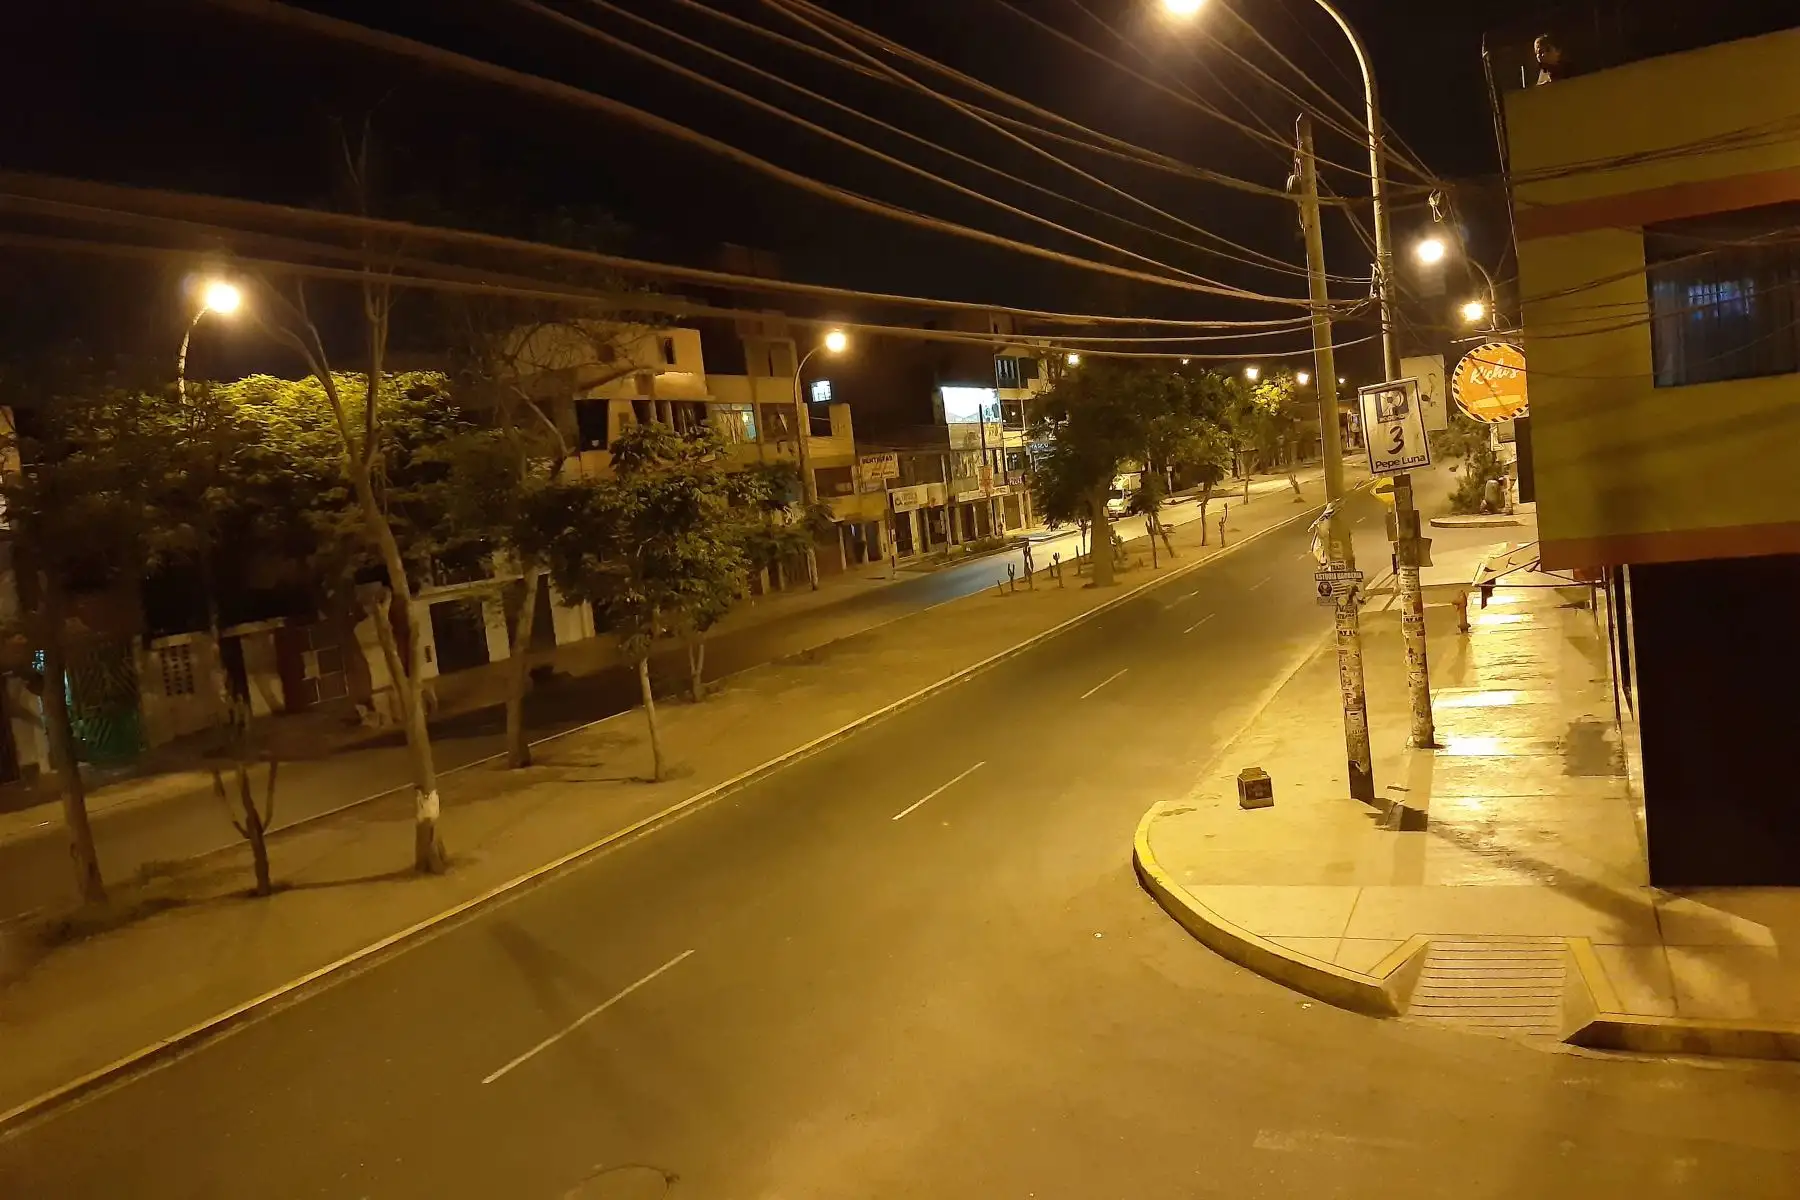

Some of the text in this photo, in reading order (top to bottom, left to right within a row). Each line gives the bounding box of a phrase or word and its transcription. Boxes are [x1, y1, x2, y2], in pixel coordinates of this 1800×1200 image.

[1387, 425, 1405, 455] 3
[1375, 454, 1426, 469] Pepe Luna
